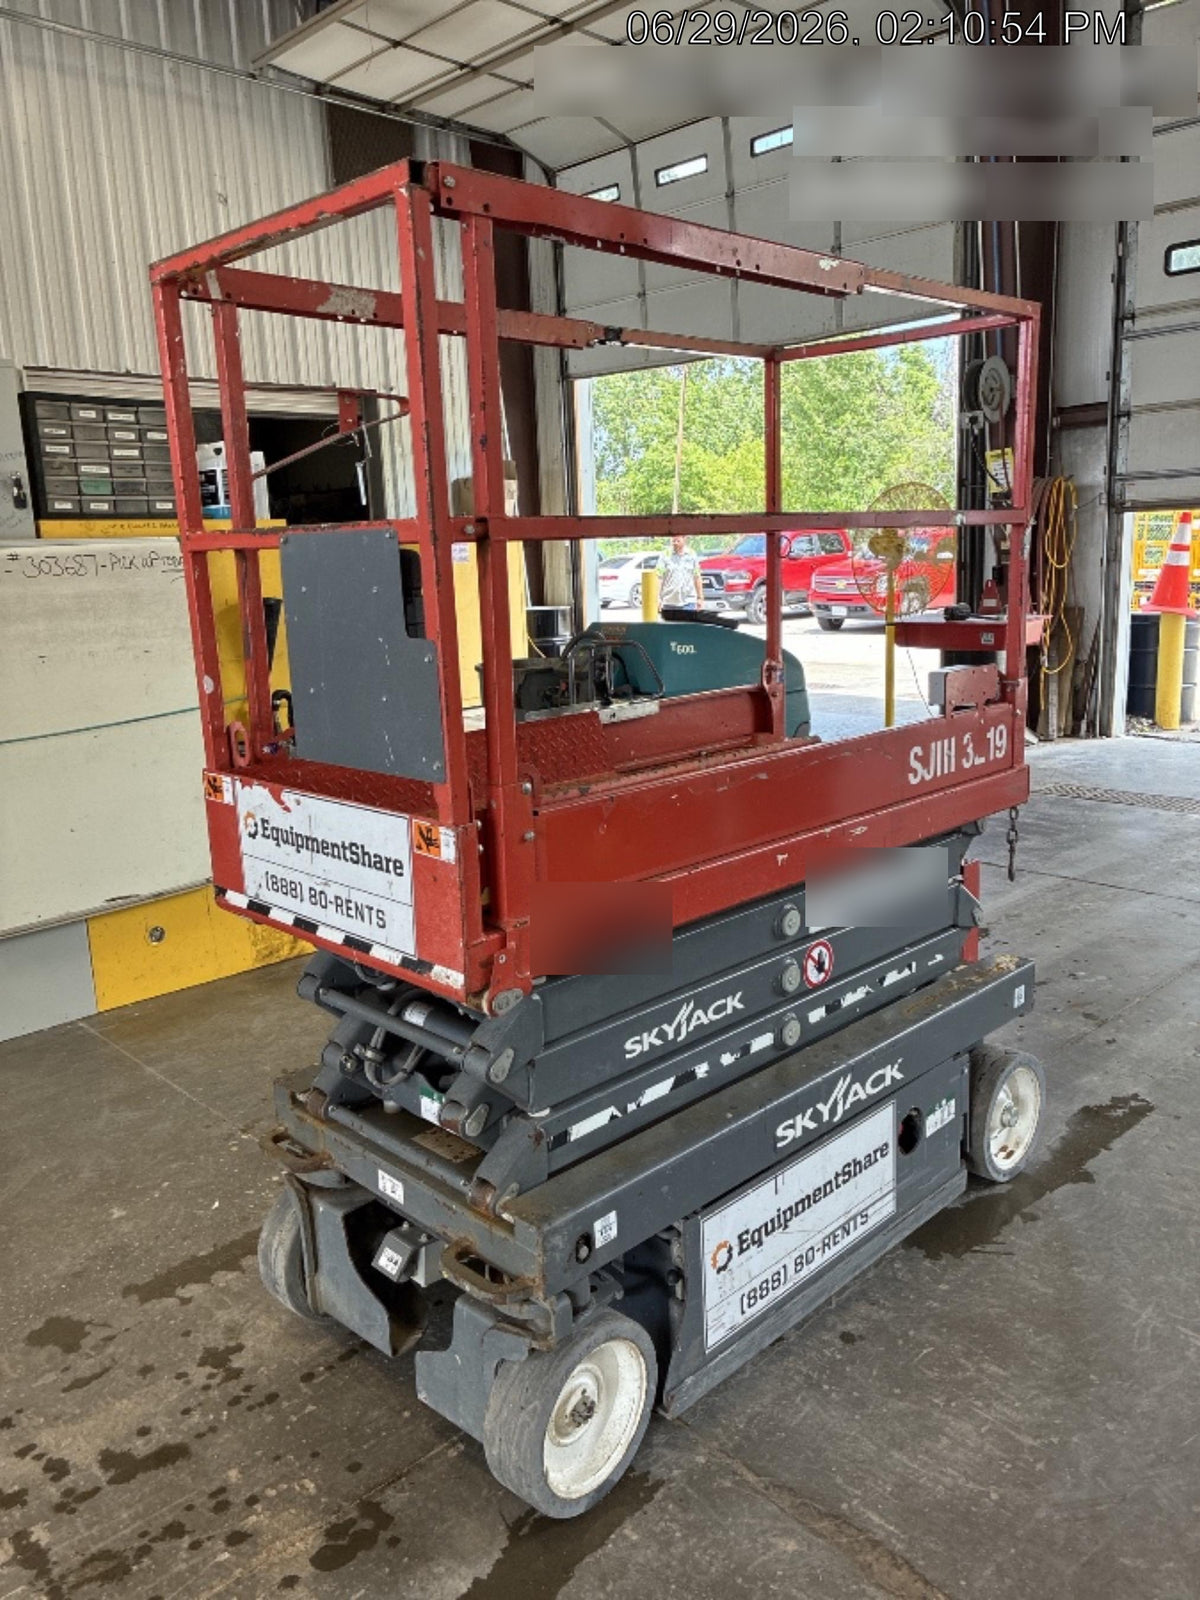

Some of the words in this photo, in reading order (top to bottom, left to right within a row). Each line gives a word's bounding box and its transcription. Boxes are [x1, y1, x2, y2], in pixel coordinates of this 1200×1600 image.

[260, 817, 404, 877] EquipmentShare
[265, 871, 304, 903] (888)
[308, 885, 387, 930] 80-RENTS
[624, 990, 745, 1060] SKYJACK
[775, 1057, 905, 1148] SKYJACK
[736, 1140, 890, 1257] EquipmentShare
[740, 1264, 789, 1316] (888)
[794, 1210, 870, 1274] 80-RENTS
